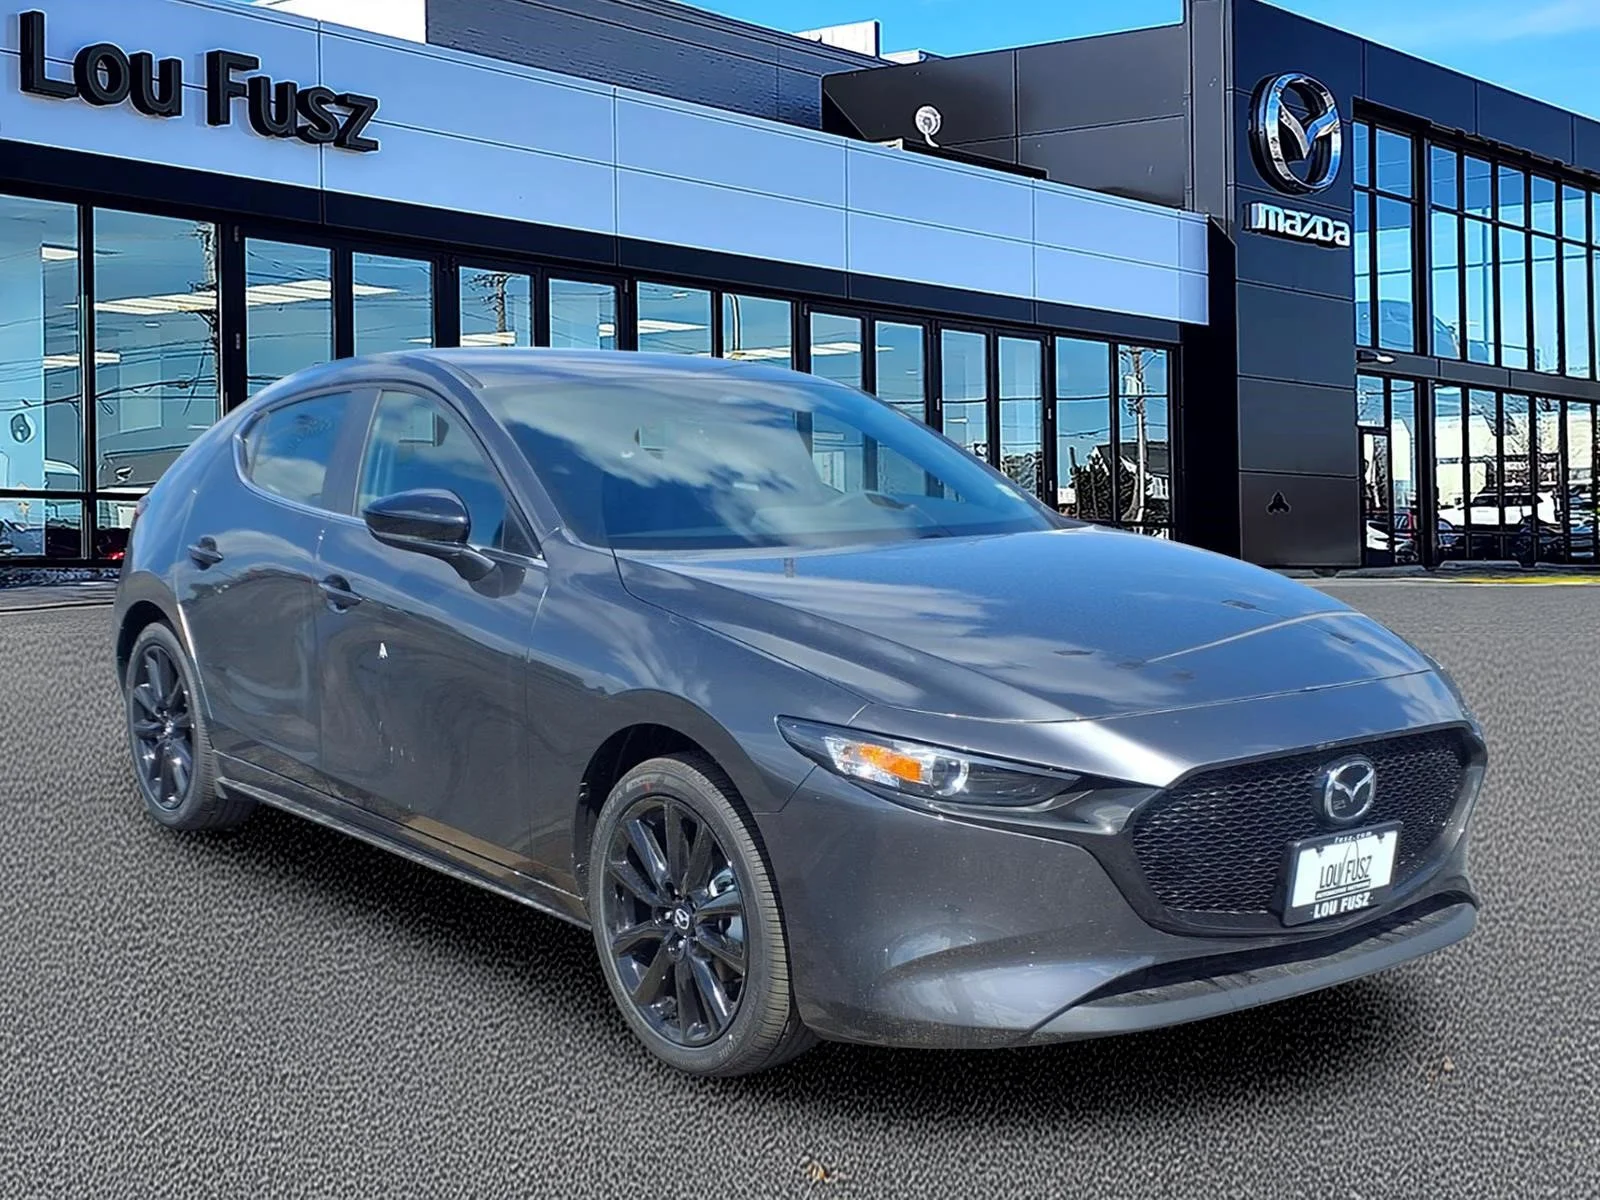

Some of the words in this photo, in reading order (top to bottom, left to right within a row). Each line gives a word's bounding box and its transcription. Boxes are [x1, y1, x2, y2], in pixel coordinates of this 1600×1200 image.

[20, 10, 182, 118] Lou
[206, 49, 380, 153] Fusz
[1319, 862, 1341, 889] LOU
[1345, 855, 1372, 883] FUSZ
[1313, 900, 1337, 919] LOU
[1340, 892, 1371, 913] FUSZ
